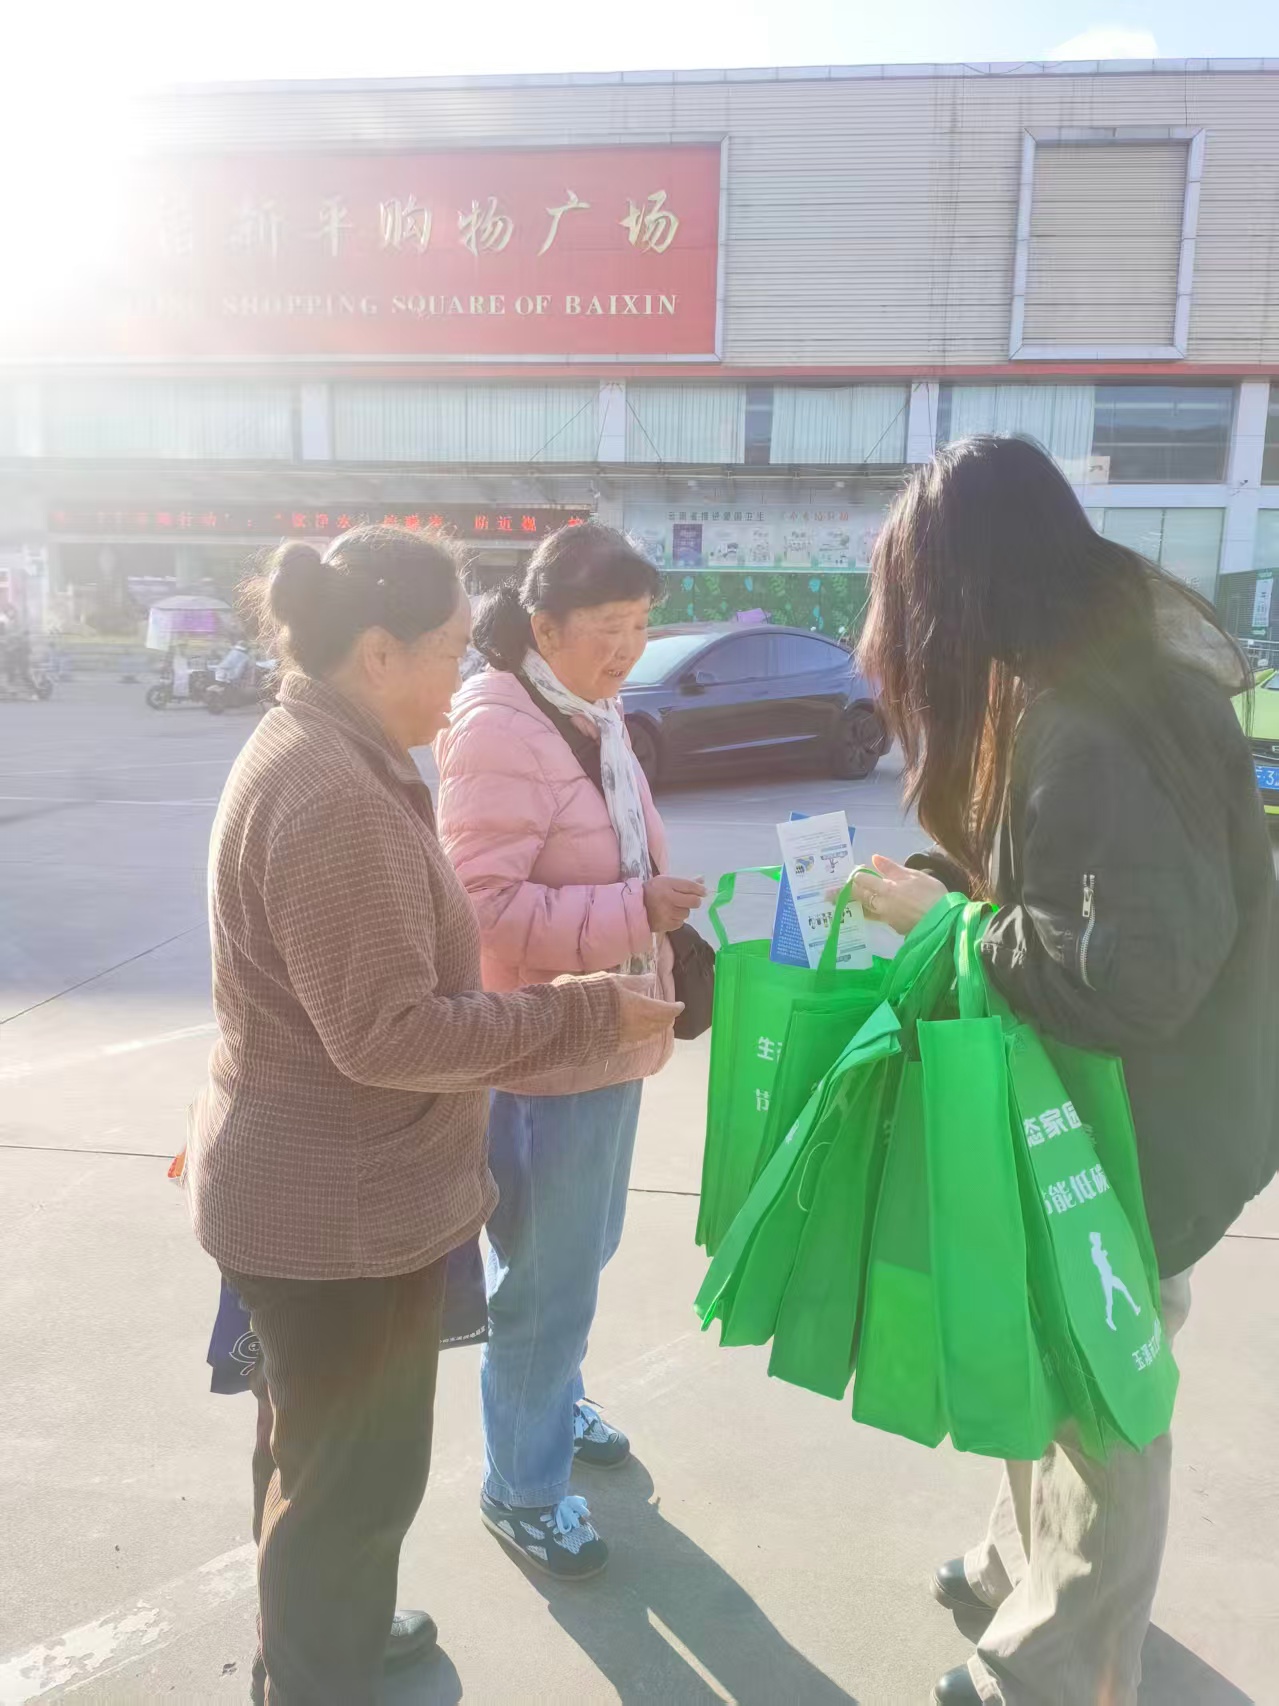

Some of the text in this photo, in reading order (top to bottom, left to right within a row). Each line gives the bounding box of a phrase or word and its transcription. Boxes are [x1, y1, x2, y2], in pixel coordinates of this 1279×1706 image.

[223, 294, 378, 316] SHOPPING
[391, 294, 505, 316] SQUARE
[515, 293, 552, 315] OF
[565, 293, 679, 315] BAIXIN
[1041, 1163, 1111, 1215] 能低碳
